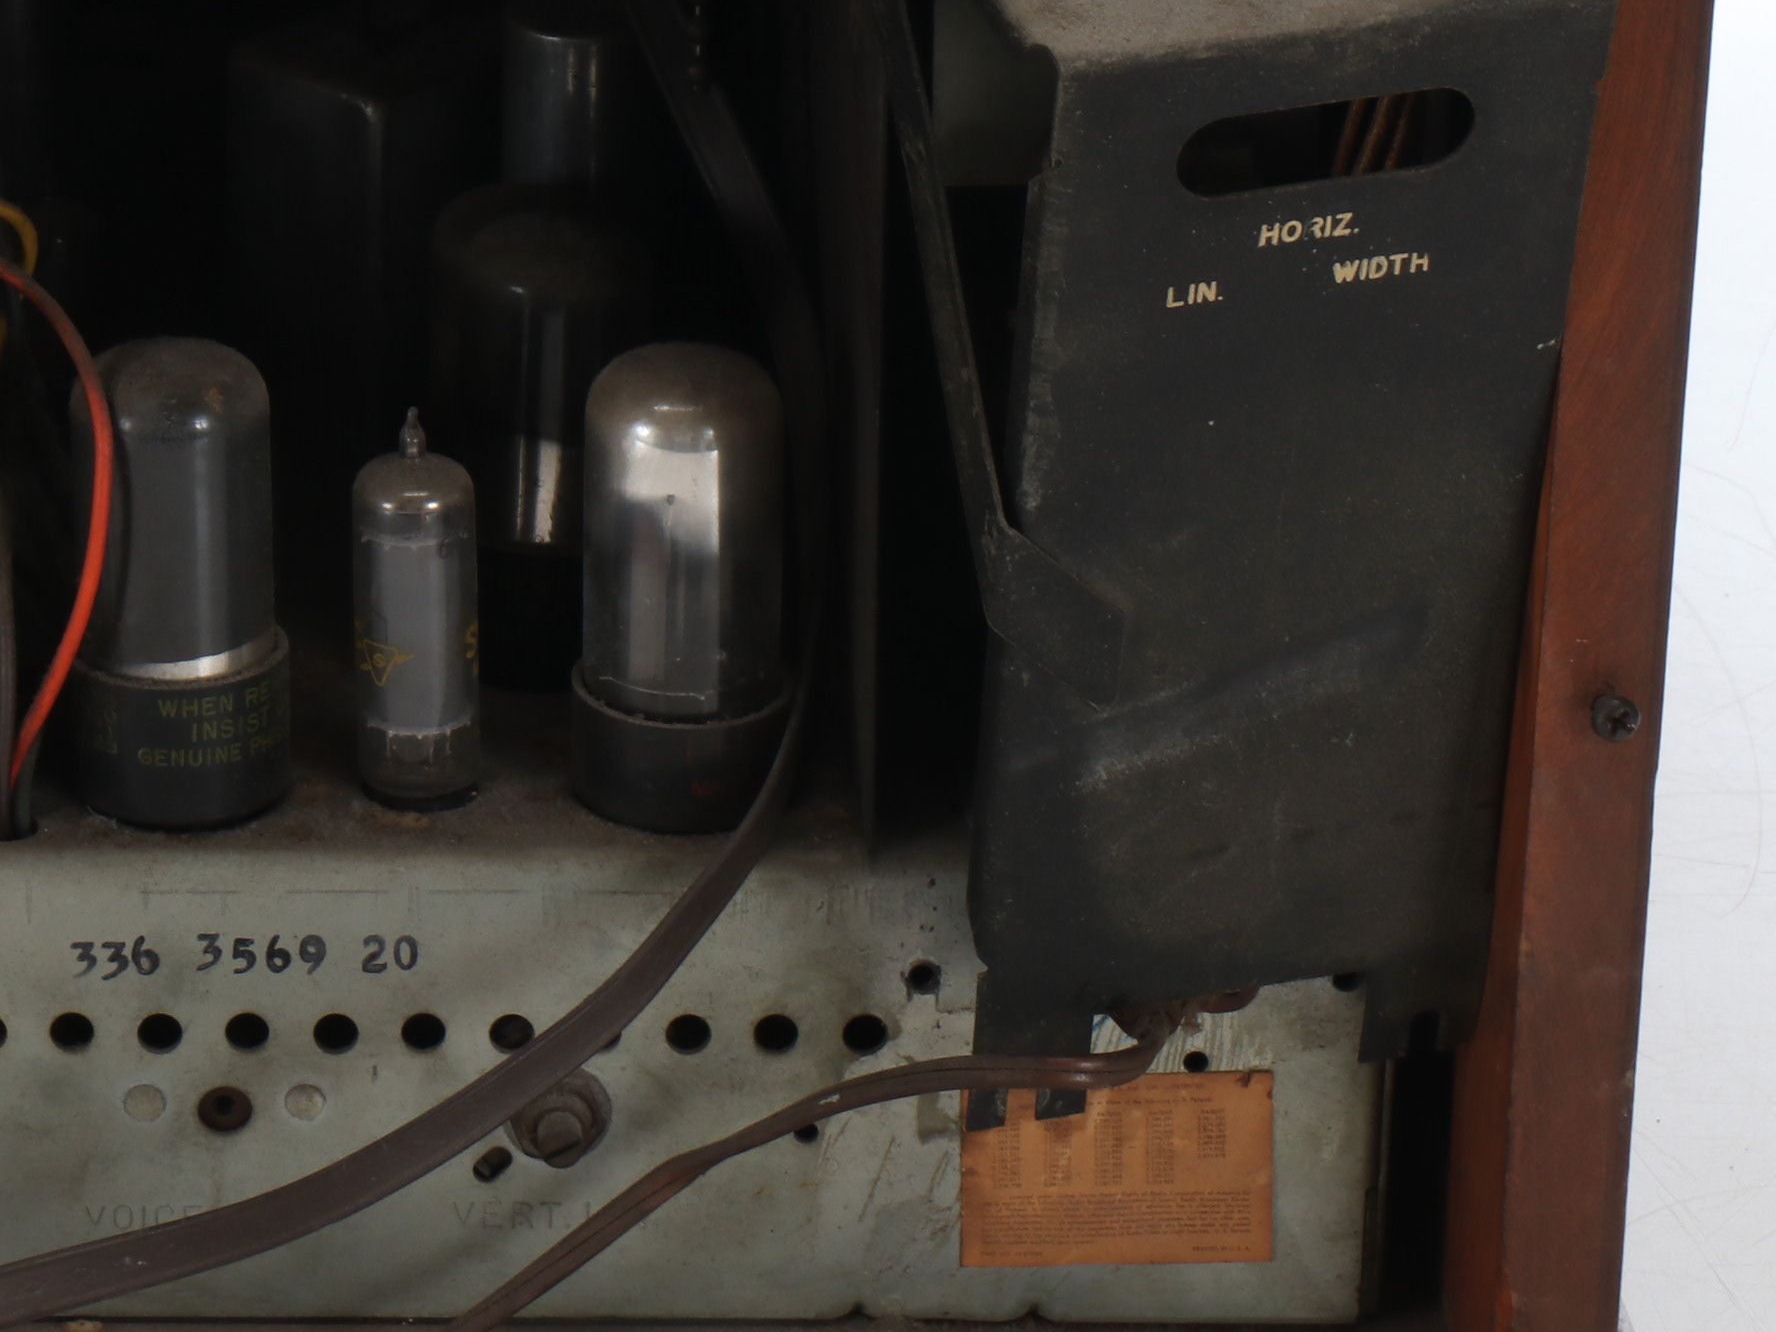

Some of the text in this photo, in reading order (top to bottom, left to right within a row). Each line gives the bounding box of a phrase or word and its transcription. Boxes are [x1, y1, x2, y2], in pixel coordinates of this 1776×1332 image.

[1258, 212, 1360, 248] HORIZ.
[1333, 253, 1430, 284] WIDTH
[1166, 281, 1223, 308] LIN.
[158, 693, 234, 718] WHEN
[137, 743, 243, 768] GENUINE
[70, 933, 419, 980] 336 3569 20
